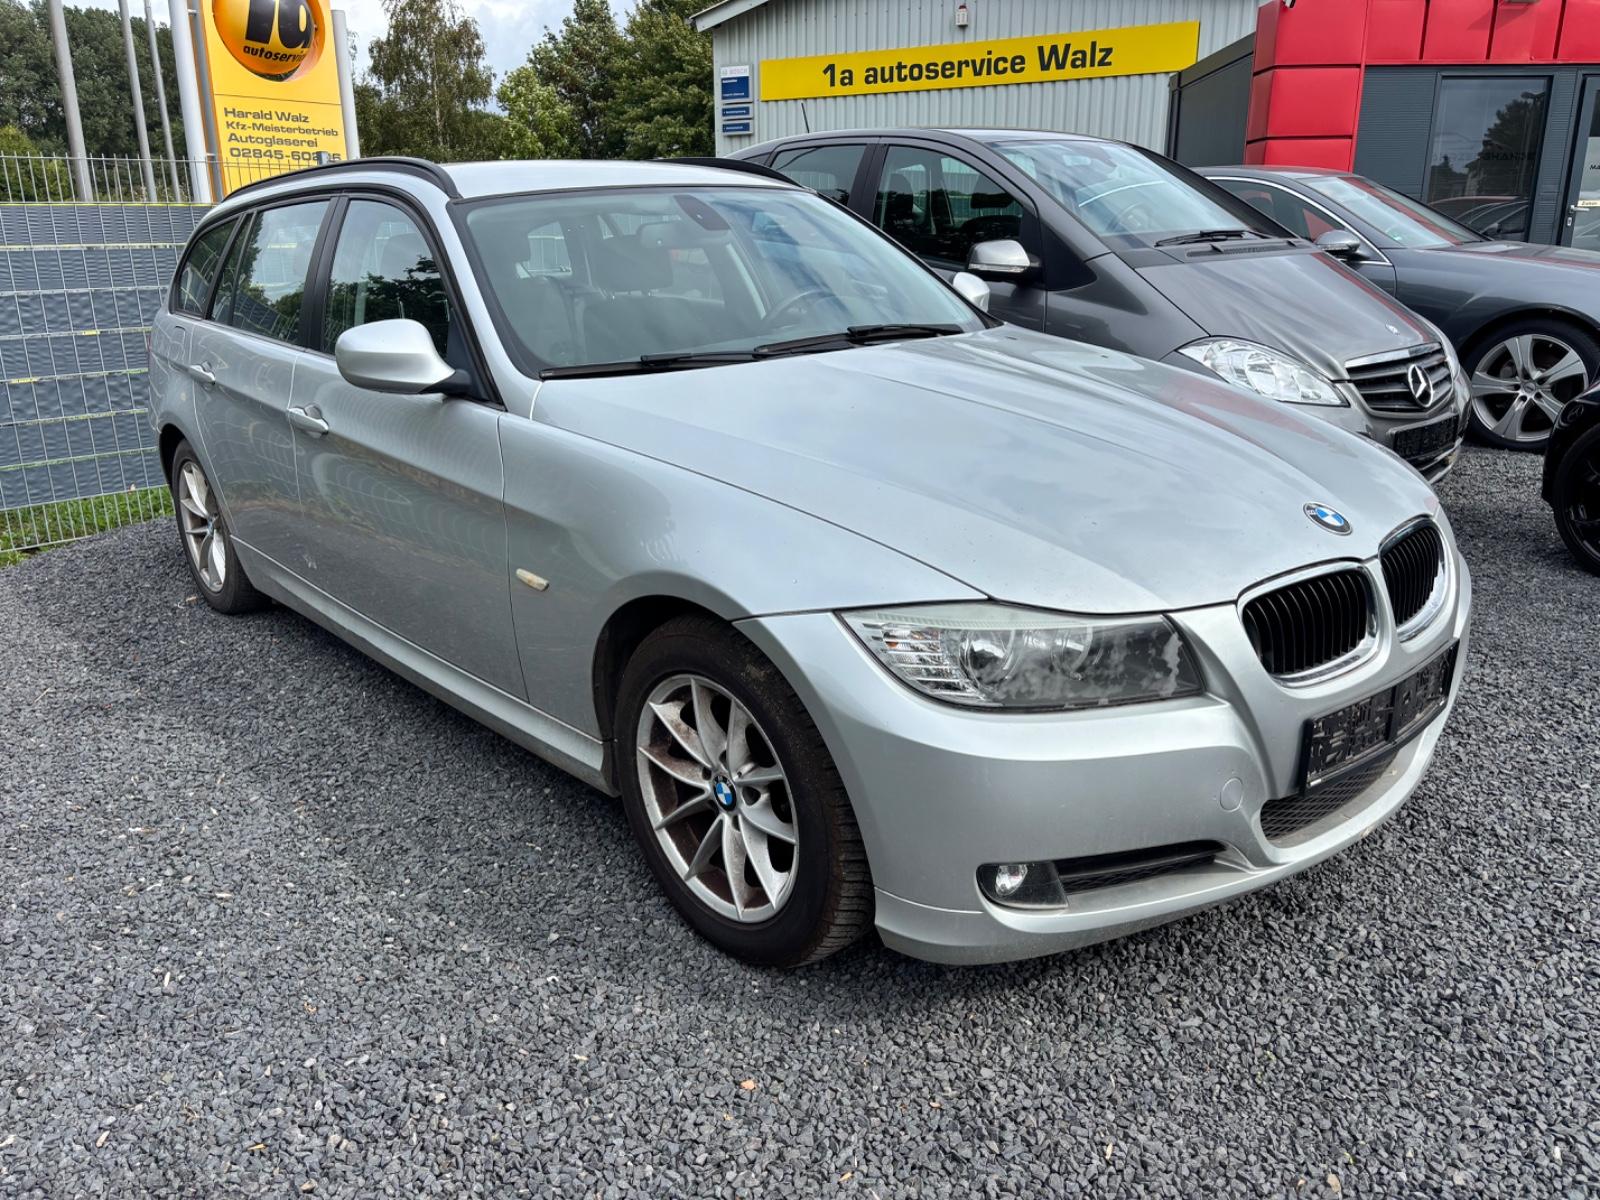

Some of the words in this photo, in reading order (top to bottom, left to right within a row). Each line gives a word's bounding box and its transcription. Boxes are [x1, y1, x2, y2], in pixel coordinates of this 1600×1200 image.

[822, 63, 853, 88] 1a
[864, 50, 1026, 86] autoservice
[1037, 41, 1113, 71] Walz
[224, 107, 273, 121] Harald
[275, 111, 310, 123] Walz
[226, 121, 339, 137] Kfz-Meisterbetrieb
[228, 133, 318, 148] Autoglaserei
